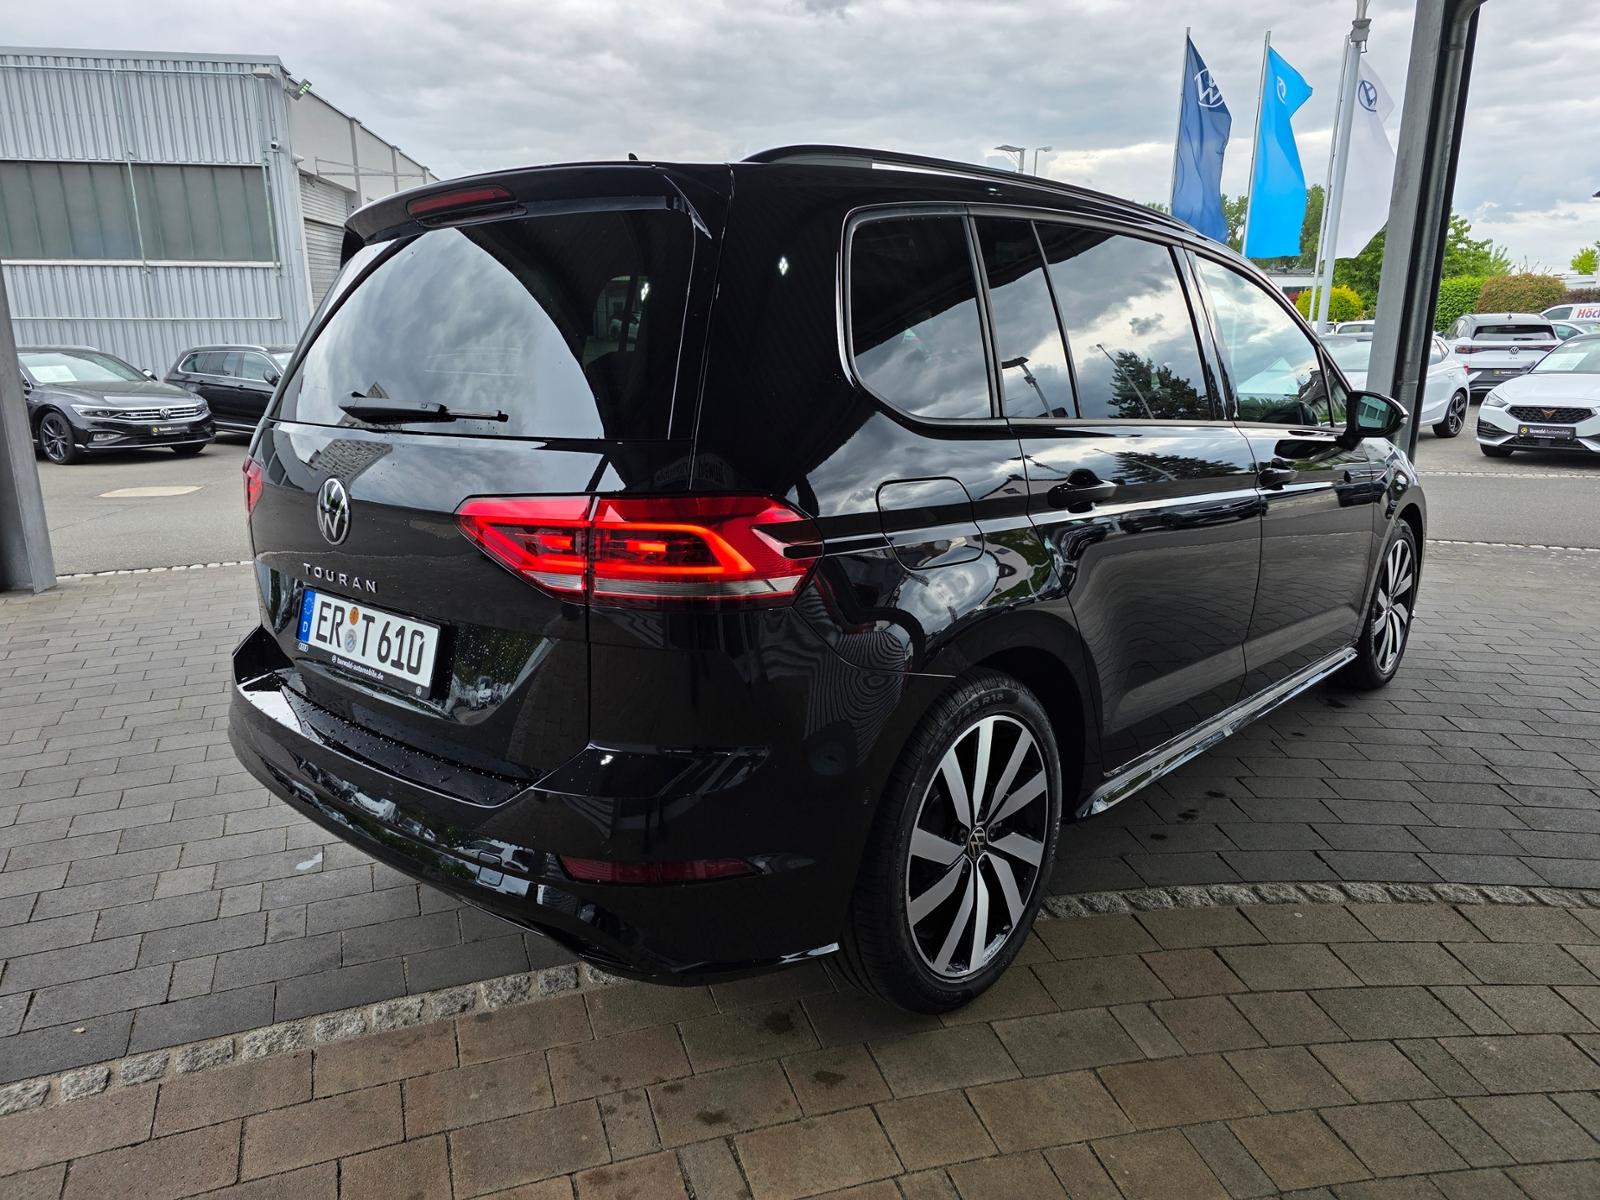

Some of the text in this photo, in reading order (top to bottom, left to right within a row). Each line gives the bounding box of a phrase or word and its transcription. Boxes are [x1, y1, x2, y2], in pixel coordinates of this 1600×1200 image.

[303, 562, 378, 594] TOURAN
[302, 621, 309, 633] D
[315, 600, 426, 676] ER T 610
